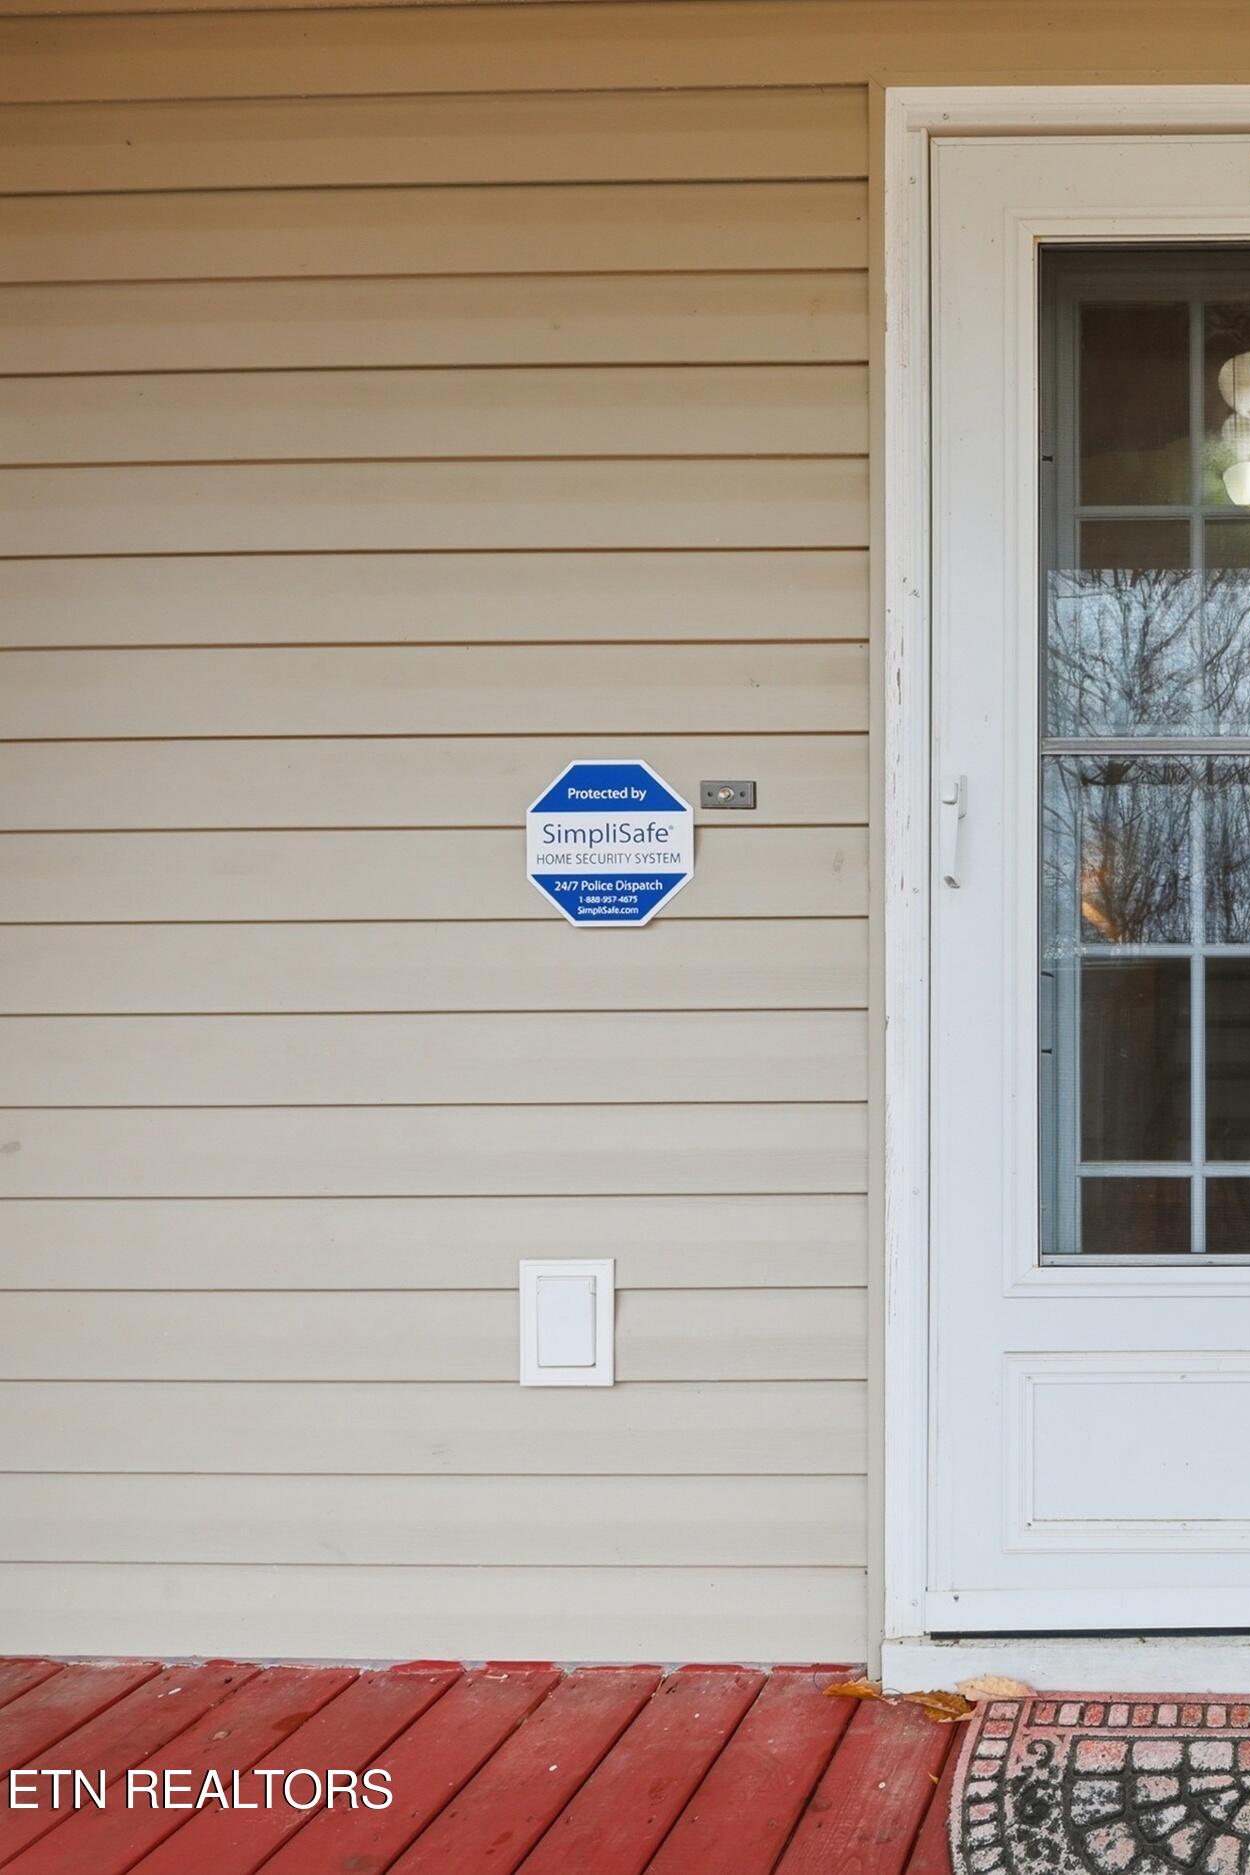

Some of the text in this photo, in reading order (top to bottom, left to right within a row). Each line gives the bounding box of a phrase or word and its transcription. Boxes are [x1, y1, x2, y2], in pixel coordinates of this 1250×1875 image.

[567, 787, 647, 801] Protected by
[536, 853, 681, 865] HOME SECURITY SYSTEM
[554, 880, 663, 893] 24/7 Police Dispatch
[577, 906, 639, 916] SimpliSafe.com
